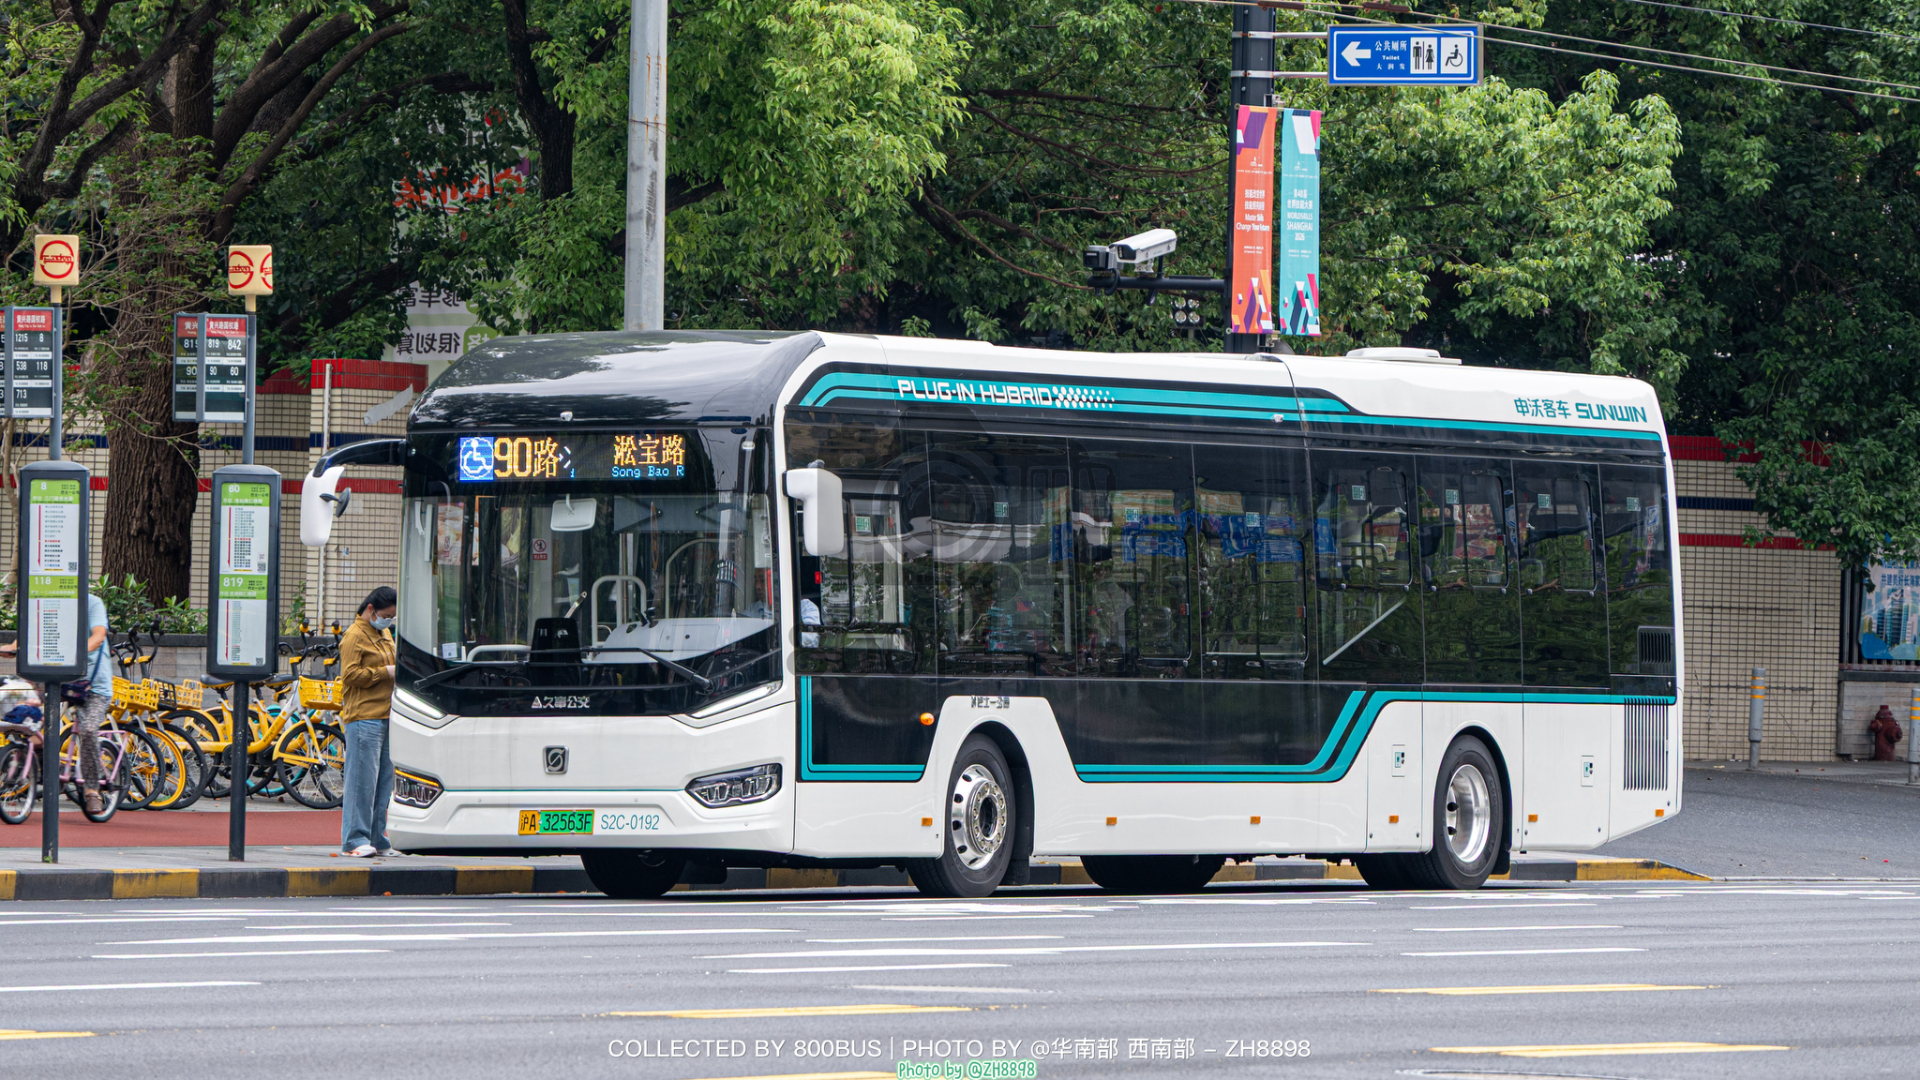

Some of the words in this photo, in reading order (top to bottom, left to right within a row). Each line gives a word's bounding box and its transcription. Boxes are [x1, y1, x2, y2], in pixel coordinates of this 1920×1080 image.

[1375, 40, 1407, 51] 公共厕所
[1236, 222, 1251, 232] Change
[1286, 221, 1313, 231] SHANGHAI
[15, 333, 28, 342] 1215
[39, 333, 44, 342] 8
[208, 339, 220, 348] 819
[227, 339, 241, 350] 842
[16, 361, 27, 371] 538
[36, 361, 48, 371] 118
[209, 366, 217, 375] 90
[230, 366, 239, 376] 60
[16, 389, 27, 399] 713
[897, 379, 976, 401] PLUG-IN
[979, 383, 1053, 405] HYBRID
[1514, 397, 1571, 419] 申沃客车
[1575, 402, 1647, 423] SUNWIN
[613, 434, 686, 466] 淞宝路
[611, 466, 641, 479] Song
[647, 466, 670, 477] Bao
[676, 466, 685, 477] R
[41, 481, 47, 490] 8
[34, 576, 52, 585] 118
[222, 577, 244, 587] 819
[543, 695, 591, 709] 久事公交
[600, 814, 660, 830] S2C-0192
